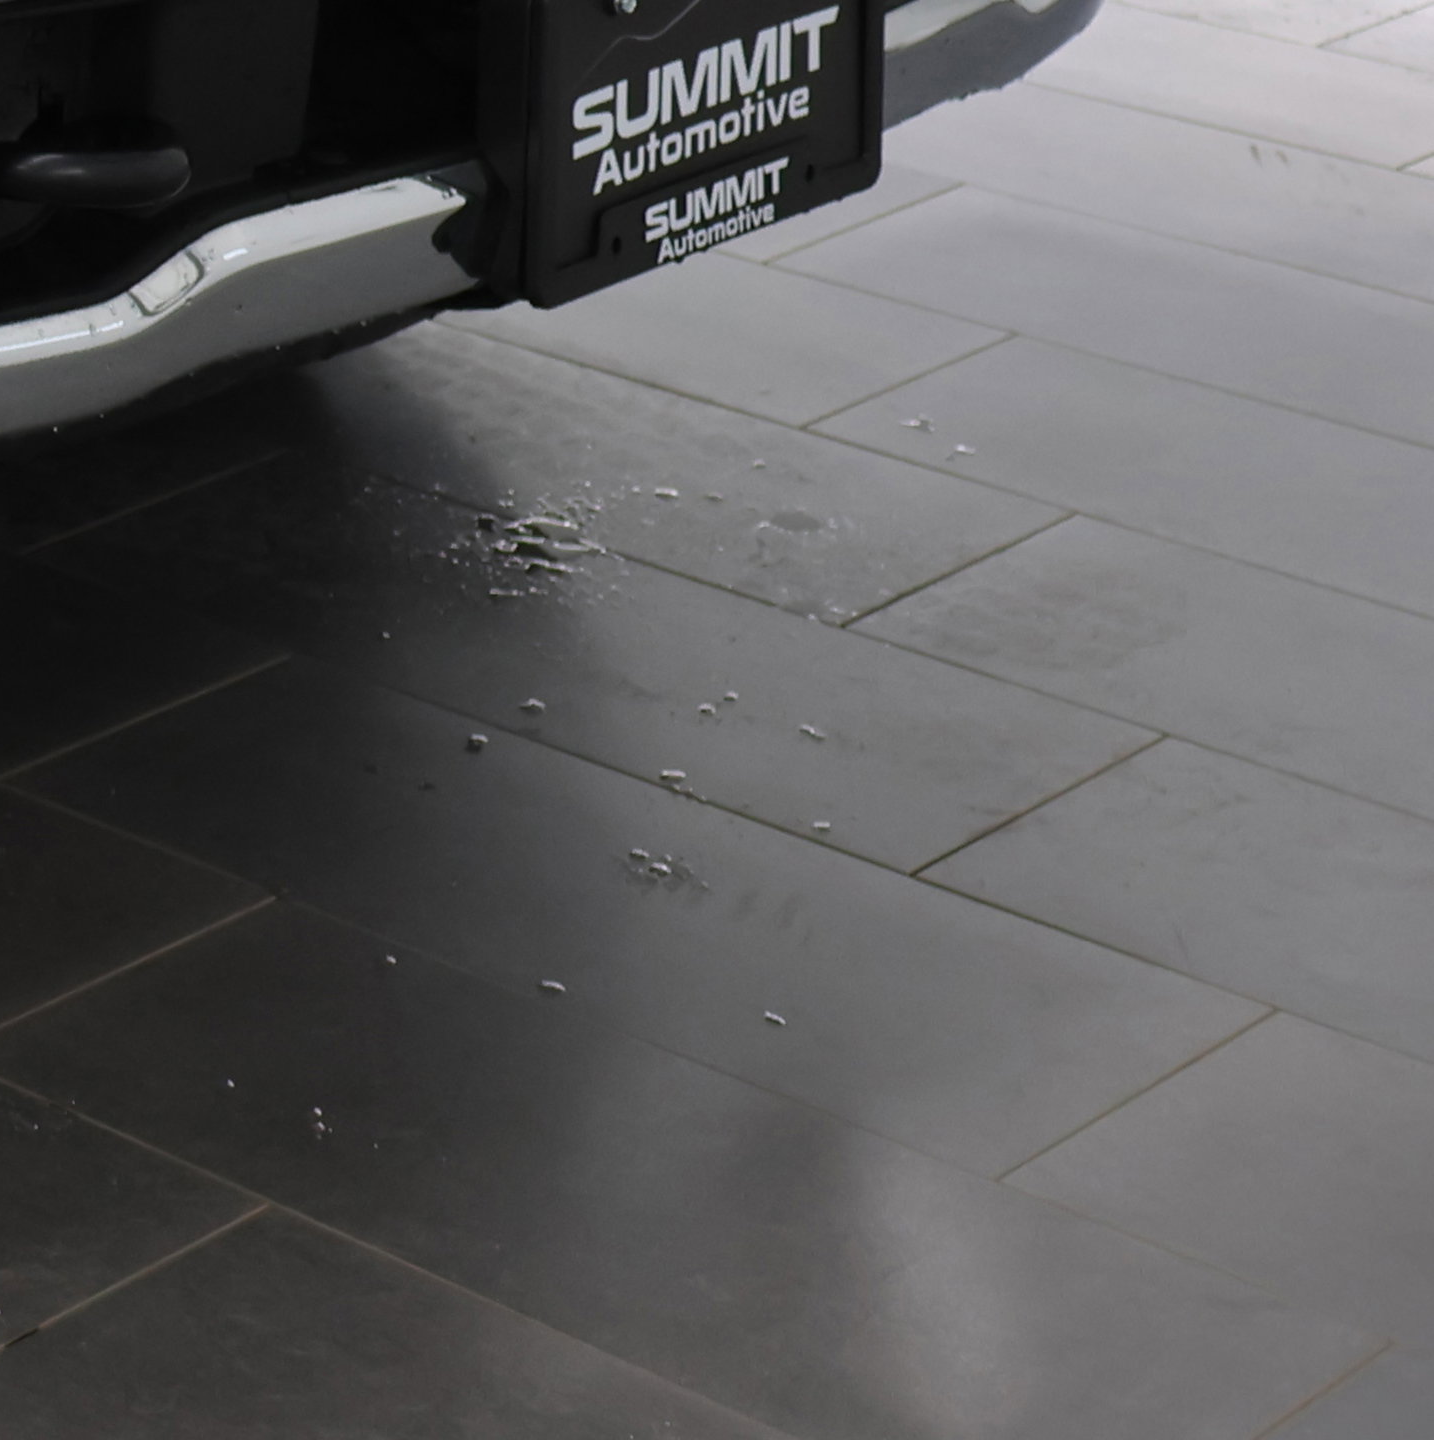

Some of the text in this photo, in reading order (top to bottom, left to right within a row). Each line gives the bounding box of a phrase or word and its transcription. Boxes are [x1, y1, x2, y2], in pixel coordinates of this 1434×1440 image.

[572, 5, 840, 160] SUMMIT
[593, 85, 810, 195] Automotive
[644, 156, 790, 243] SUMMIT
[656, 202, 776, 264] Automotive
